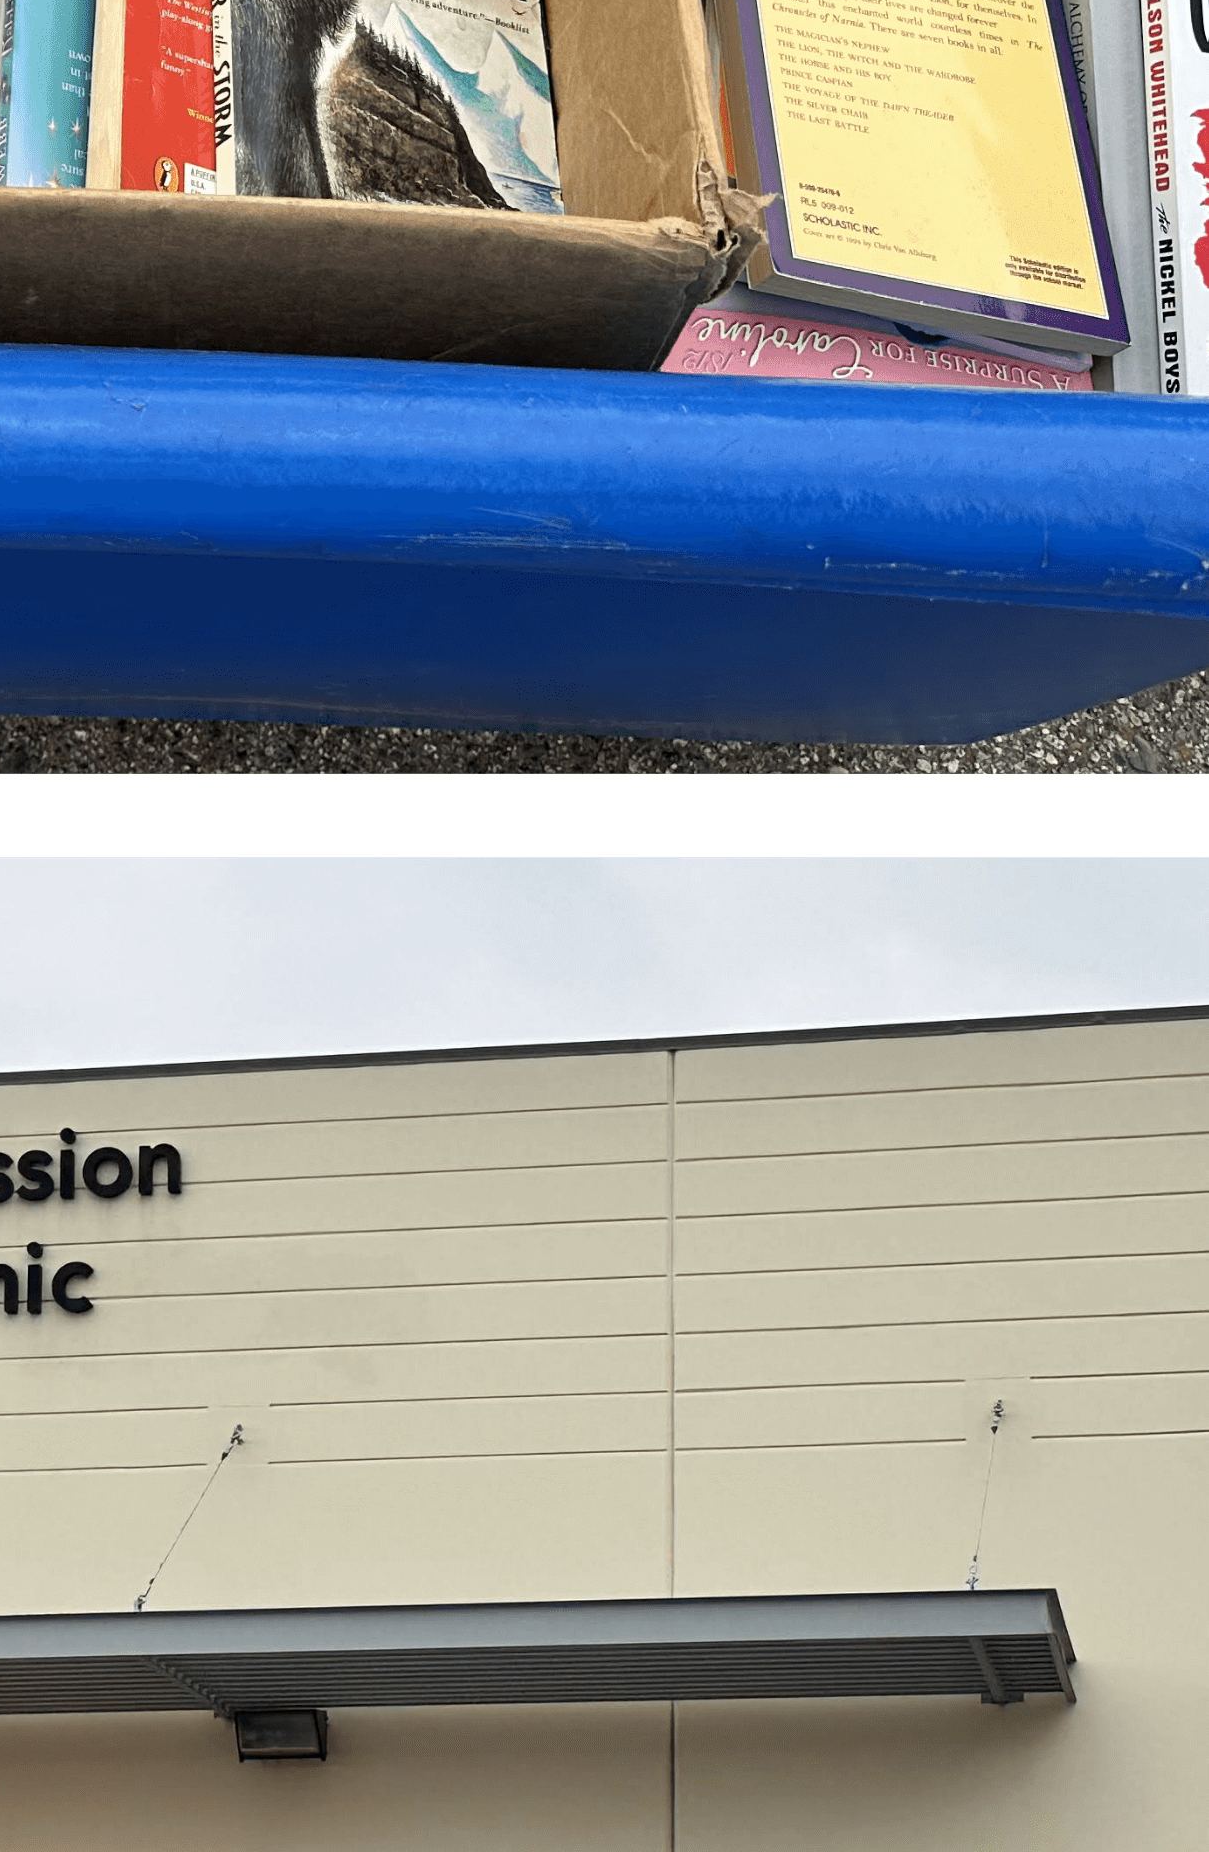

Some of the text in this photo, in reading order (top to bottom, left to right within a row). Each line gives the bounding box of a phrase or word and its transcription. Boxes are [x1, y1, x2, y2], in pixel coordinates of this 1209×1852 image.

[214, 14, 223, 29] in
[214, 33, 228, 57] the
[773, 23, 794, 35] THE
[850, 39, 891, 55] NEPHEW
[1067, 2, 1086, 84] ALCHEMY
[775, 36, 795, 49] THE
[825, 47, 845, 60] THE
[847, 51, 879, 67] WITCH
[880, 58, 902, 71] AND
[903, 63, 924, 76] THE
[925, 67, 977, 87] WARDROBE
[777, 51, 892, 83] THE HORSE AND HIS BOY
[779, 65, 853, 89] PRINCE CASPIAN
[213, 60, 232, 147] STORM
[781, 79, 802, 92] THE
[803, 84, 842, 100] VOYAGE
[843, 92, 857, 104] OF
[859, 95, 880, 108] THE
[783, 94, 869, 120] THE SILVER CHAIR
[785, 109, 871, 135] THE LAST BATTLE
[1149, 59, 1170, 192] WHITEHEAD
[801, 211, 883, 237] SCHOLASTIC INC.
[1157, 238, 1176, 323] NICKEL
[682, 310, 885, 381] Caroline
[861, 338, 922, 363] FOR
[912, 347, 1055, 389] SURPRISE
[1162, 331, 1181, 394] BOYS
